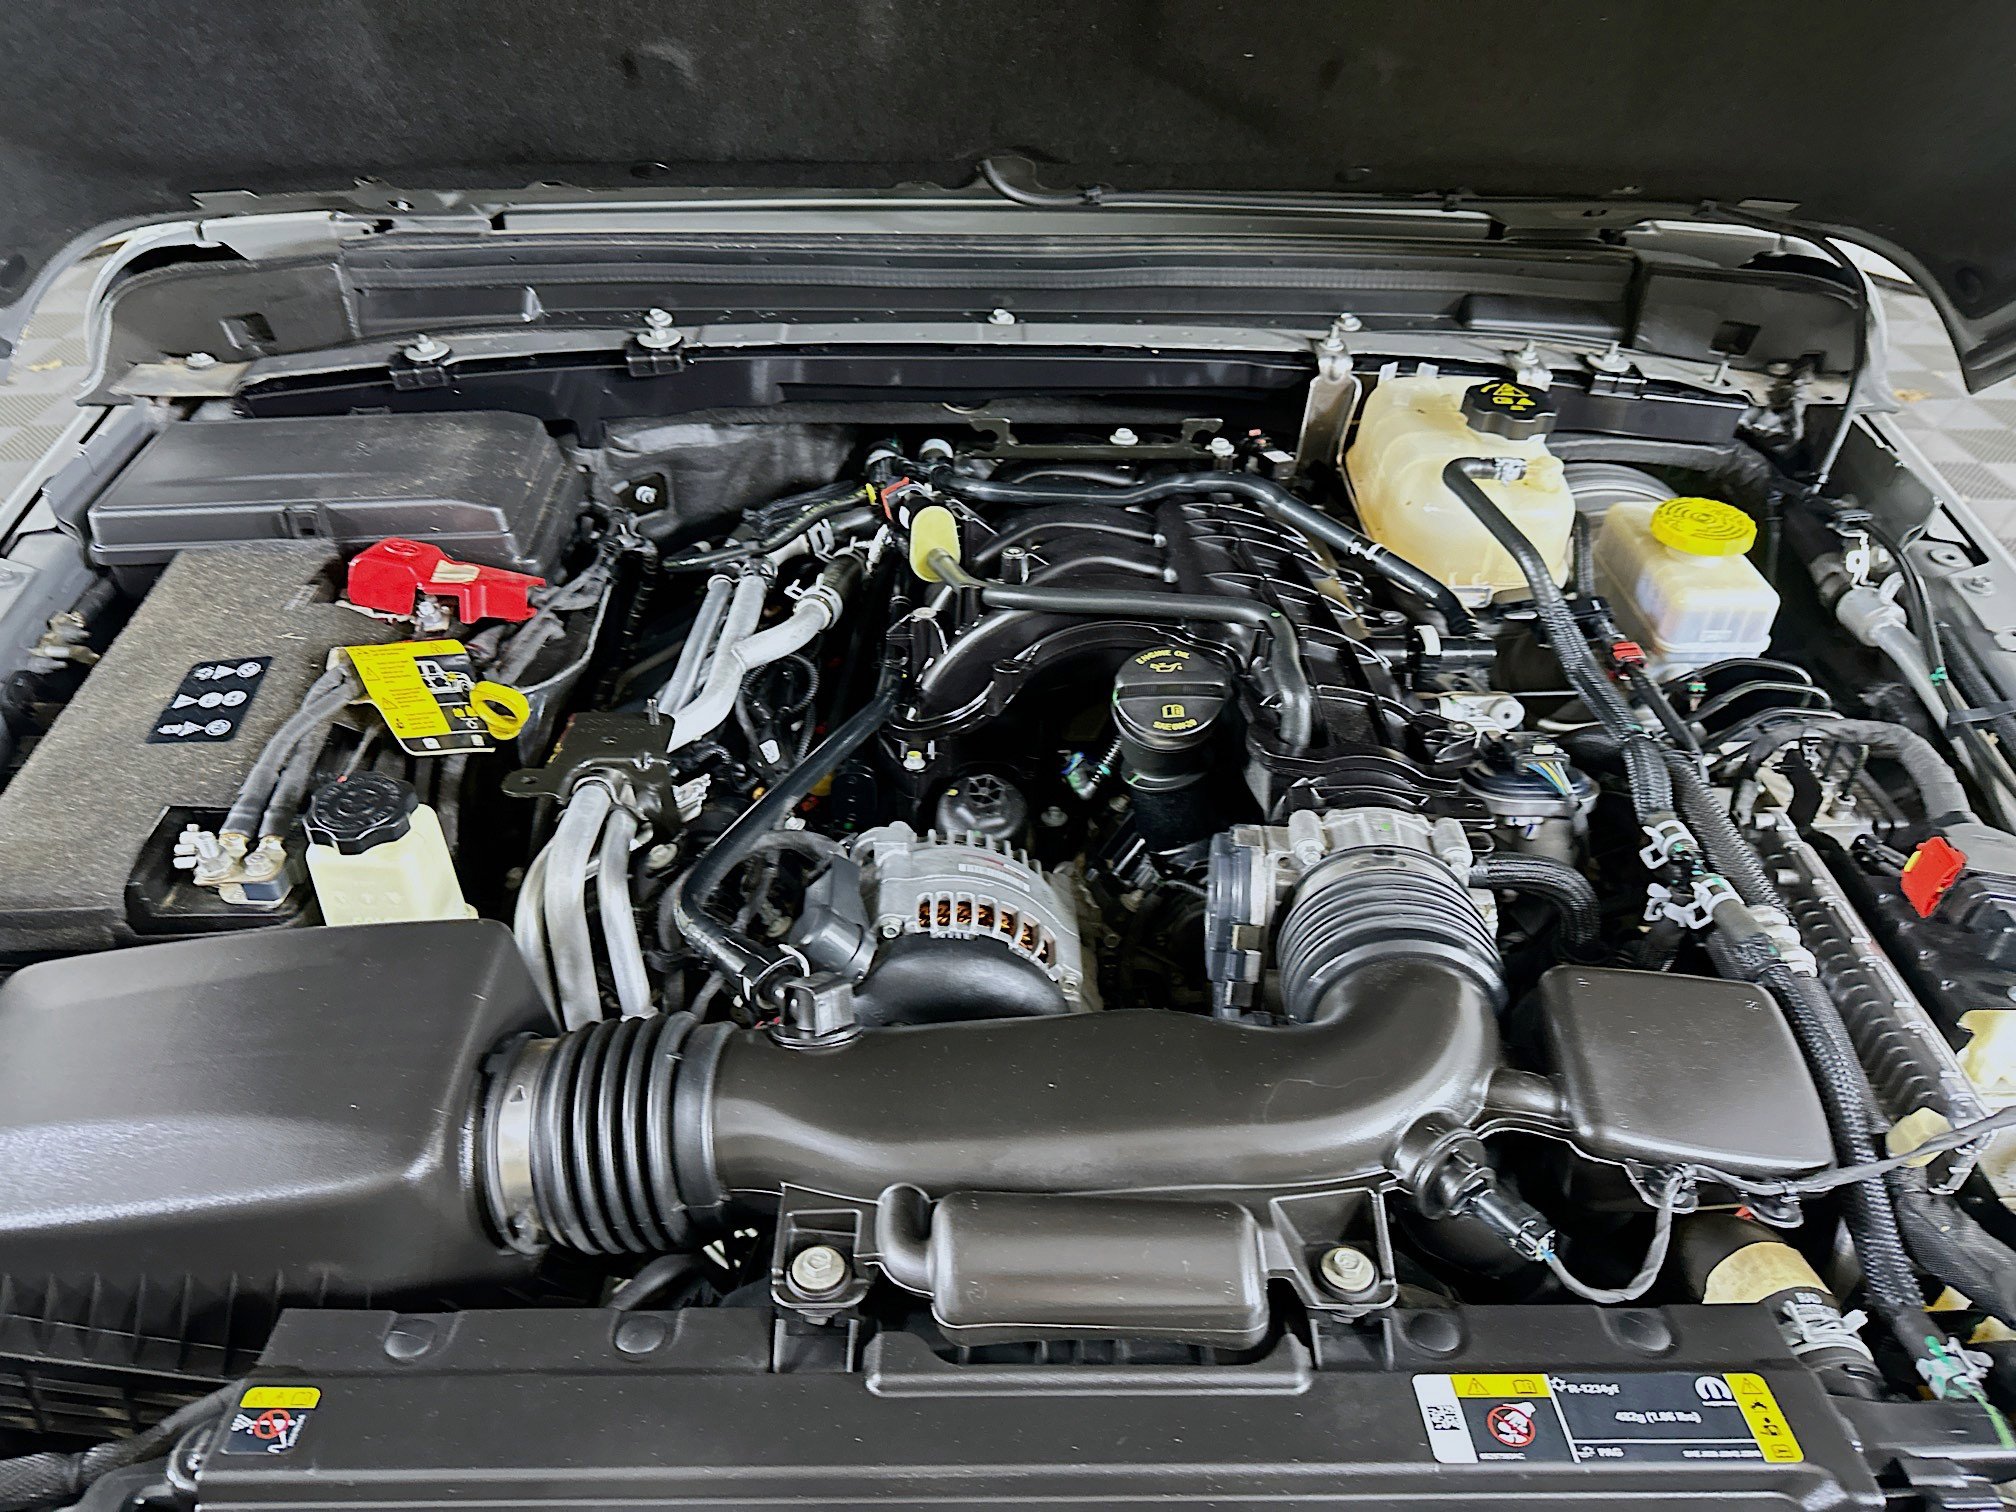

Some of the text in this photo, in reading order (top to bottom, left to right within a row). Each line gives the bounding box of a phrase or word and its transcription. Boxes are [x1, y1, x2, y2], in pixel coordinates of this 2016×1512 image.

[1135, 649, 1190, 664] ENGINE OIL
[1566, 1383, 1620, 1396] R-1234yf
